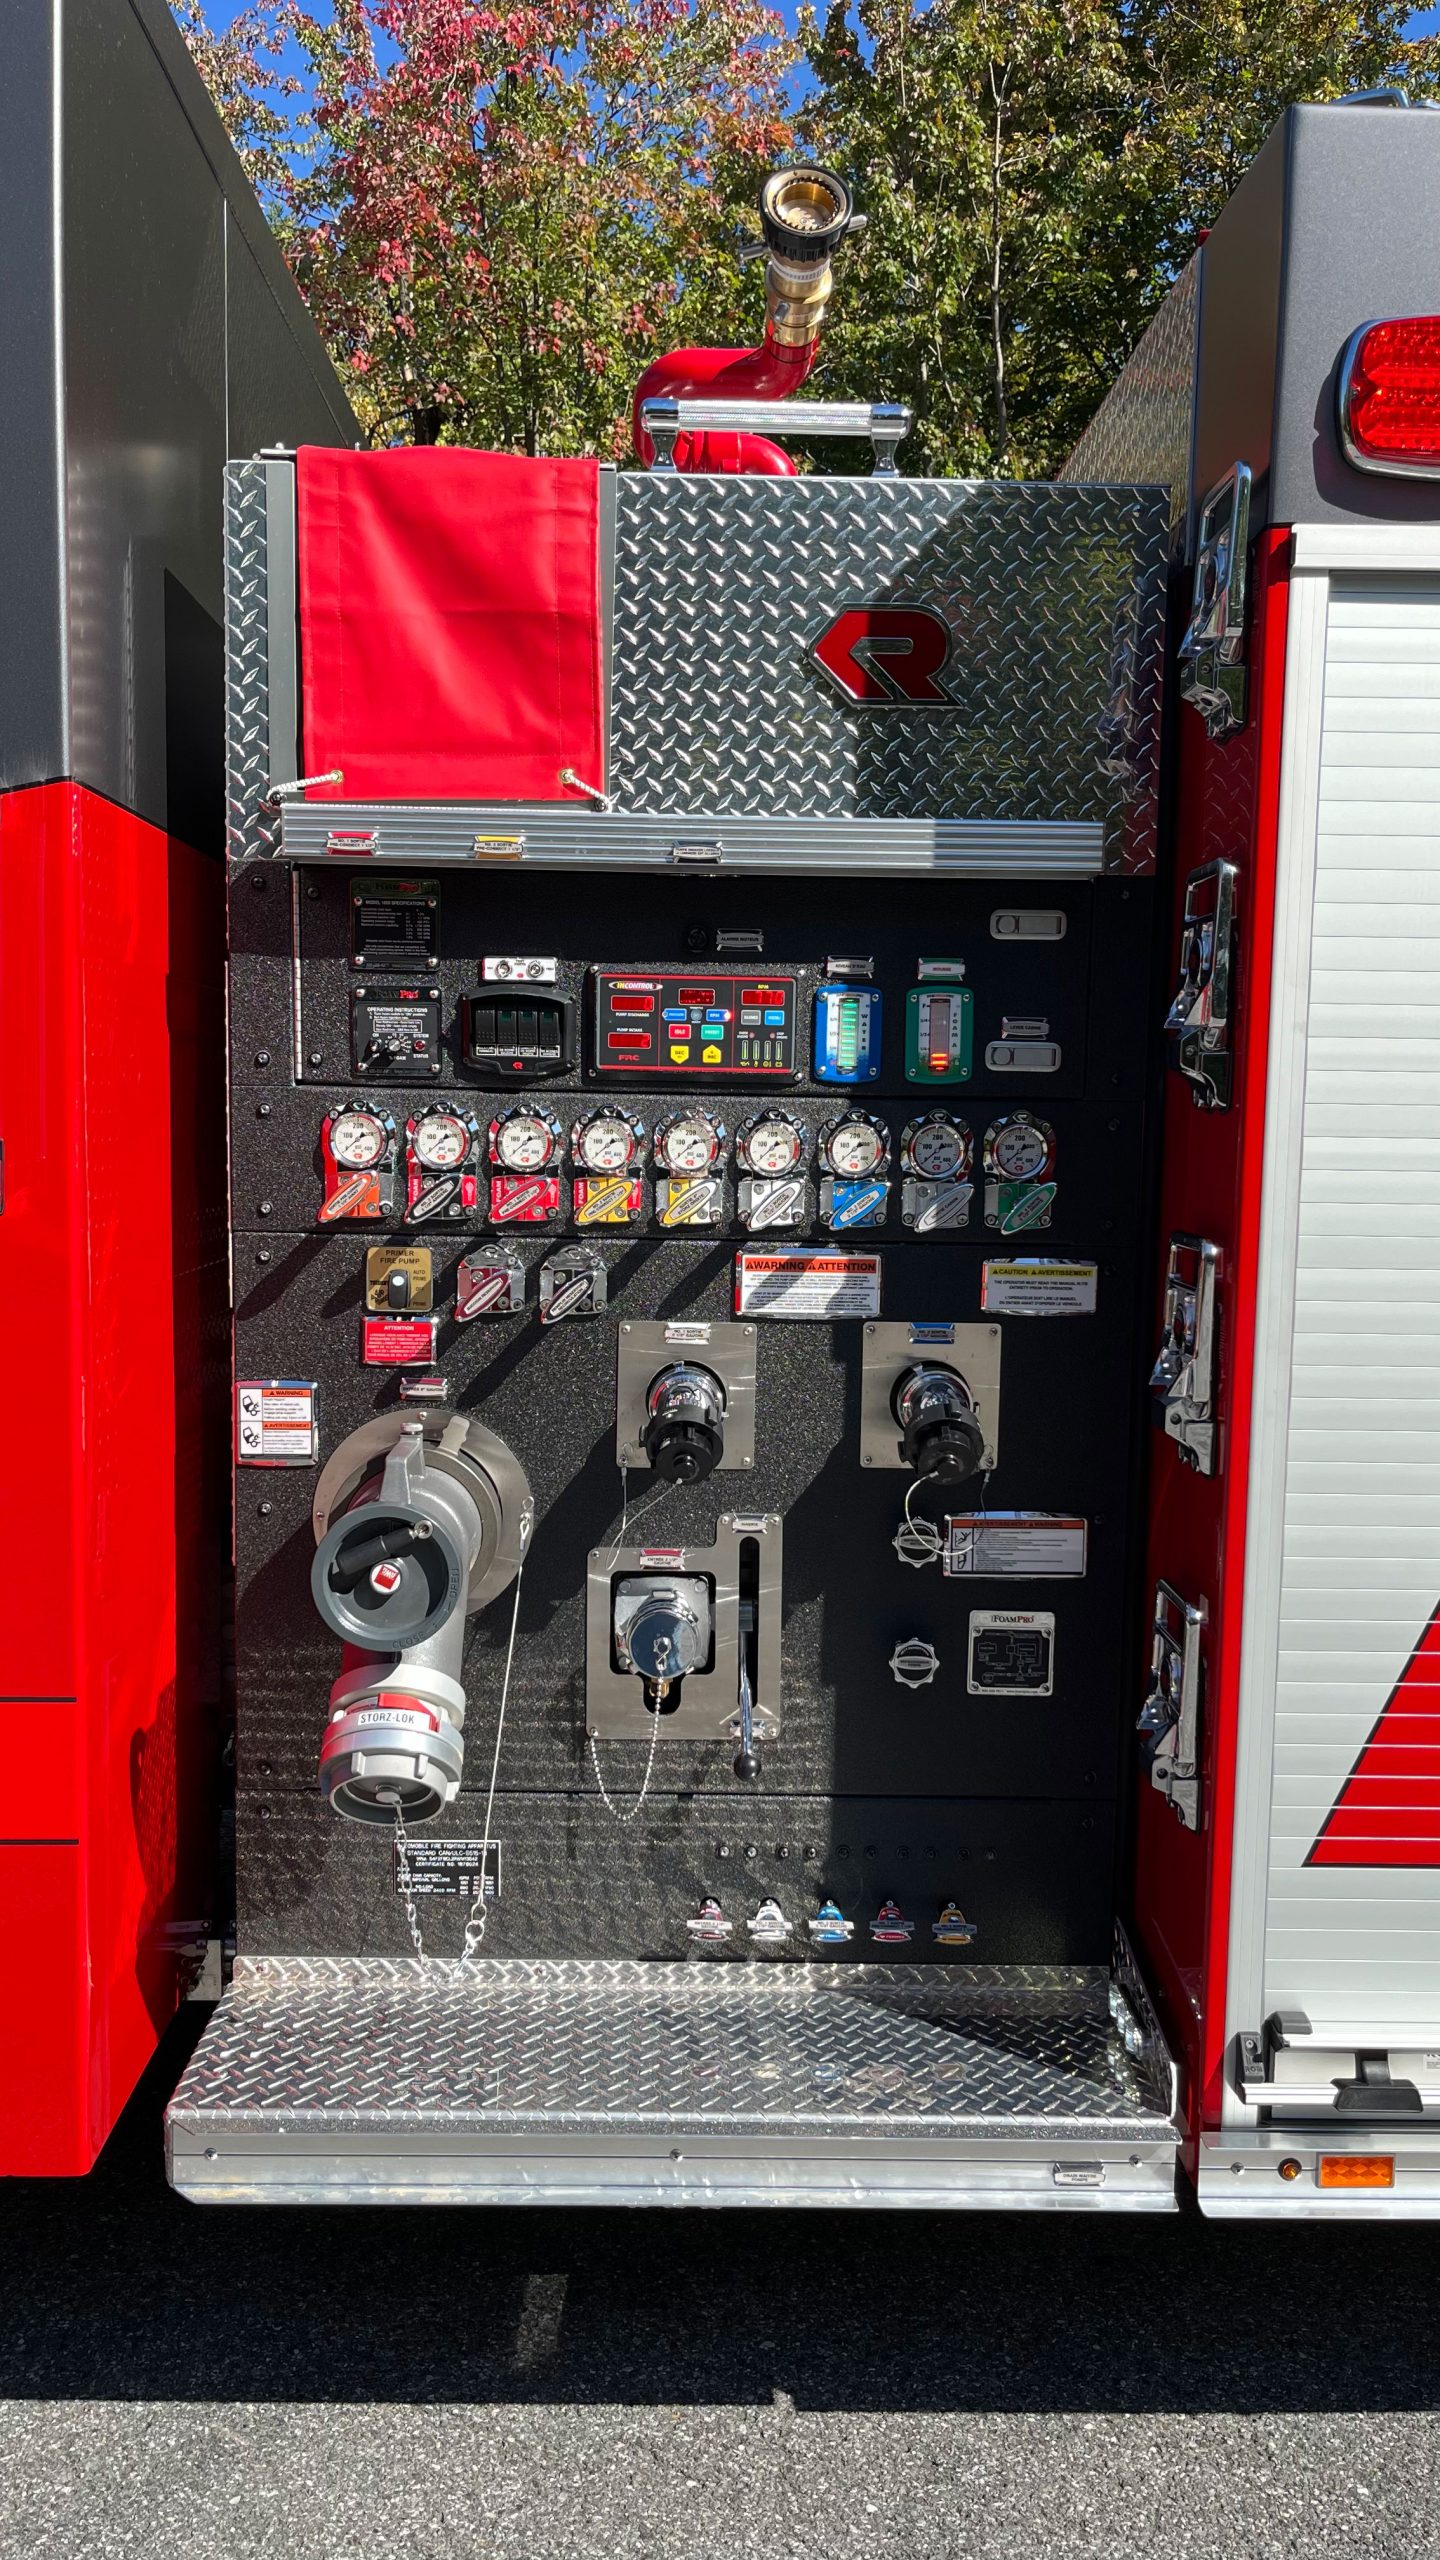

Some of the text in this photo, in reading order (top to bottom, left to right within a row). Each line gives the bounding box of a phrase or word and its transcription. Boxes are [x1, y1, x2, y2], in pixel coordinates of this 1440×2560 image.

[617, 982, 653, 990] INCONTROL
[753, 1261, 876, 1271] WARNING ATTENTION
[449, 1568, 460, 1599] OPEN
[392, 1631, 424, 1649] CLOSE
[360, 1712, 415, 1723] STORZ-LOK
